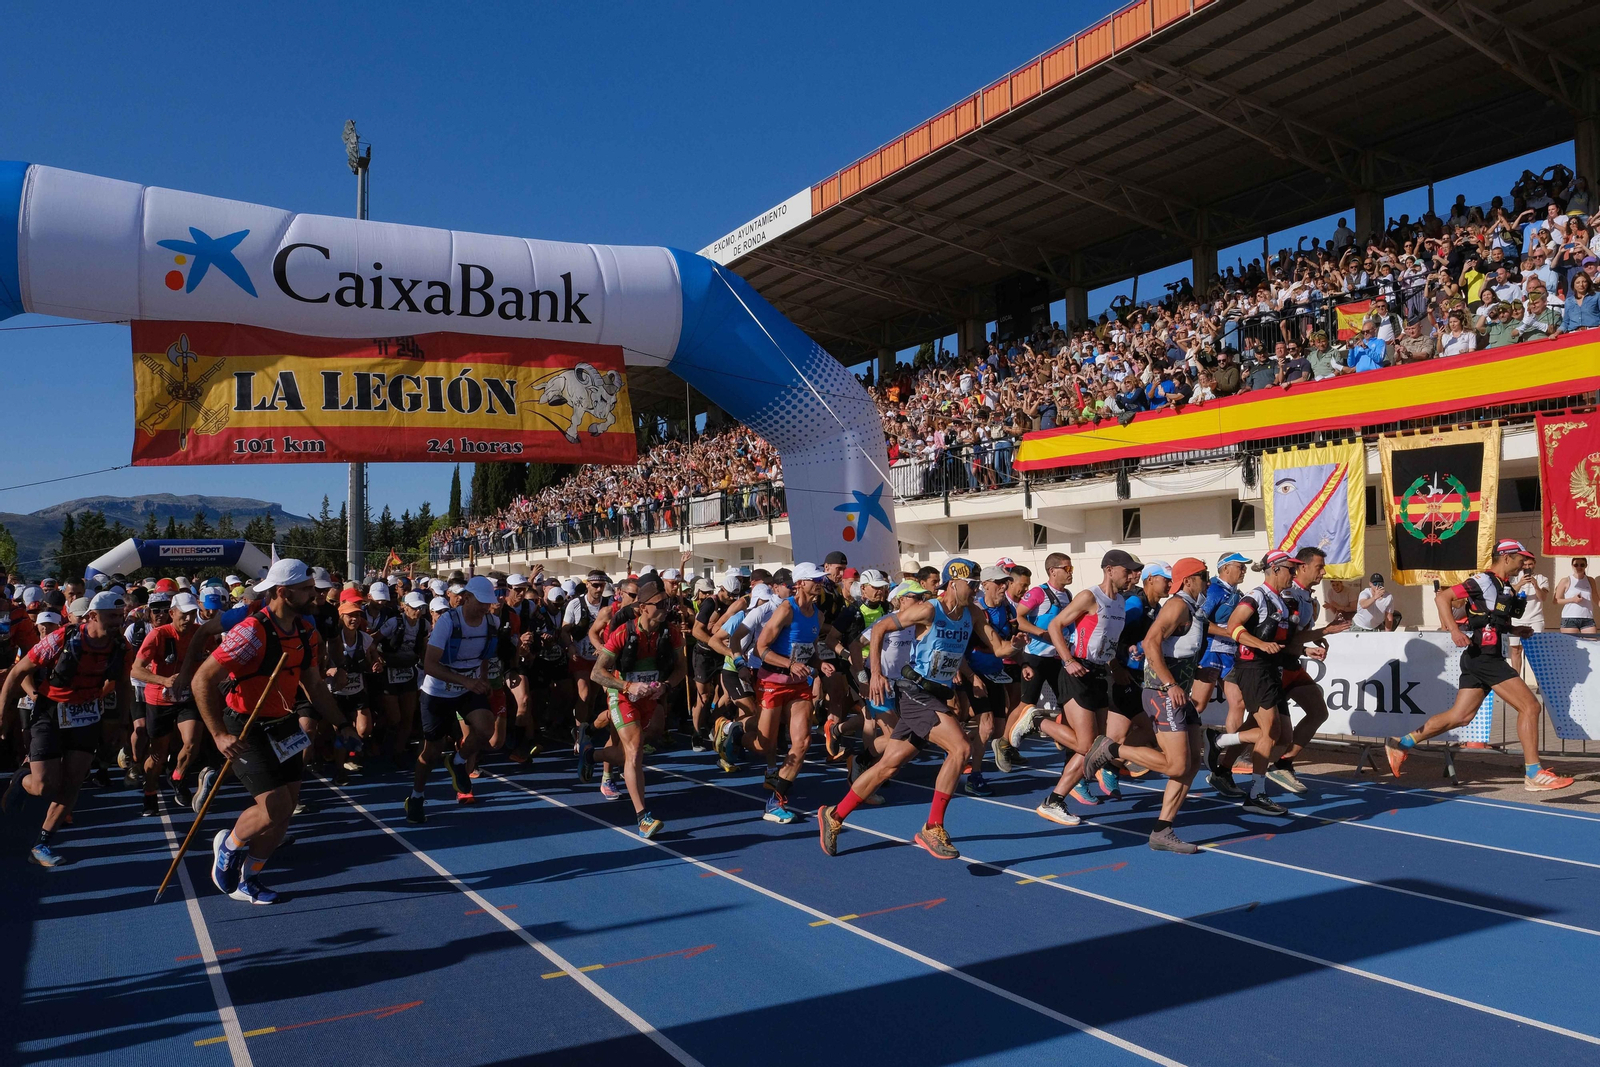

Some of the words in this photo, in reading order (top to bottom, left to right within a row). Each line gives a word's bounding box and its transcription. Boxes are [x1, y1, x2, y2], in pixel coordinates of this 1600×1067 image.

[713, 234, 737, 254] EXCMO.
[737, 204, 788, 240] AYUNTAMIENTO
[733, 245, 742, 256] DE
[743, 231, 767, 251] RONDA
[272, 242, 592, 325] CaixaBank
[232, 370, 306, 412] LA
[321, 368, 517, 416] LEGIÓN
[232, 438, 276, 454] 101
[283, 436, 326, 454] km
[427, 438, 455, 455] 24
[458, 436, 524, 454] horas
[171, 546, 221, 554] INTERSPORT
[936, 626, 969, 643] nerja
